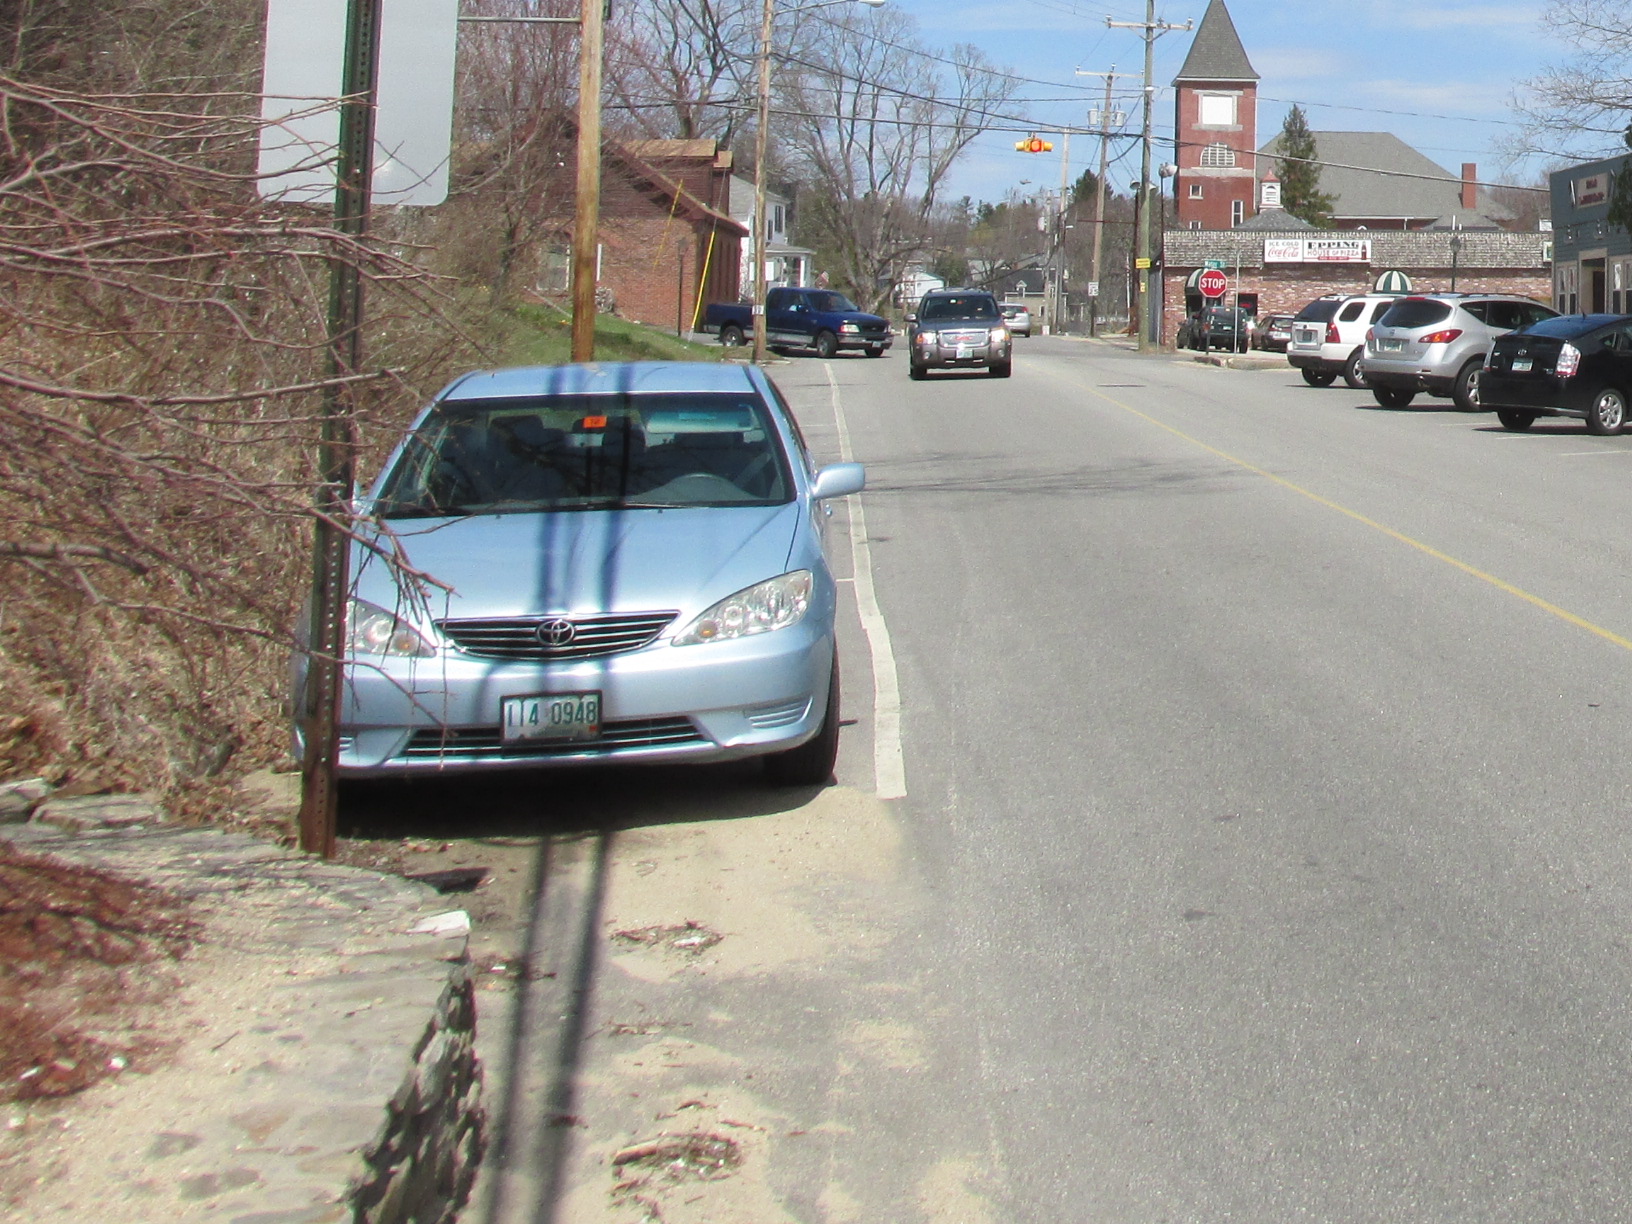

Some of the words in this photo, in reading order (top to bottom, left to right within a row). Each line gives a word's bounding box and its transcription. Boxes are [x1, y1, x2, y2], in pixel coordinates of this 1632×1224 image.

[1307, 241, 1360, 250] EPPING
[1201, 277, 1225, 289] STOP
[551, 701, 597, 725] 0948
